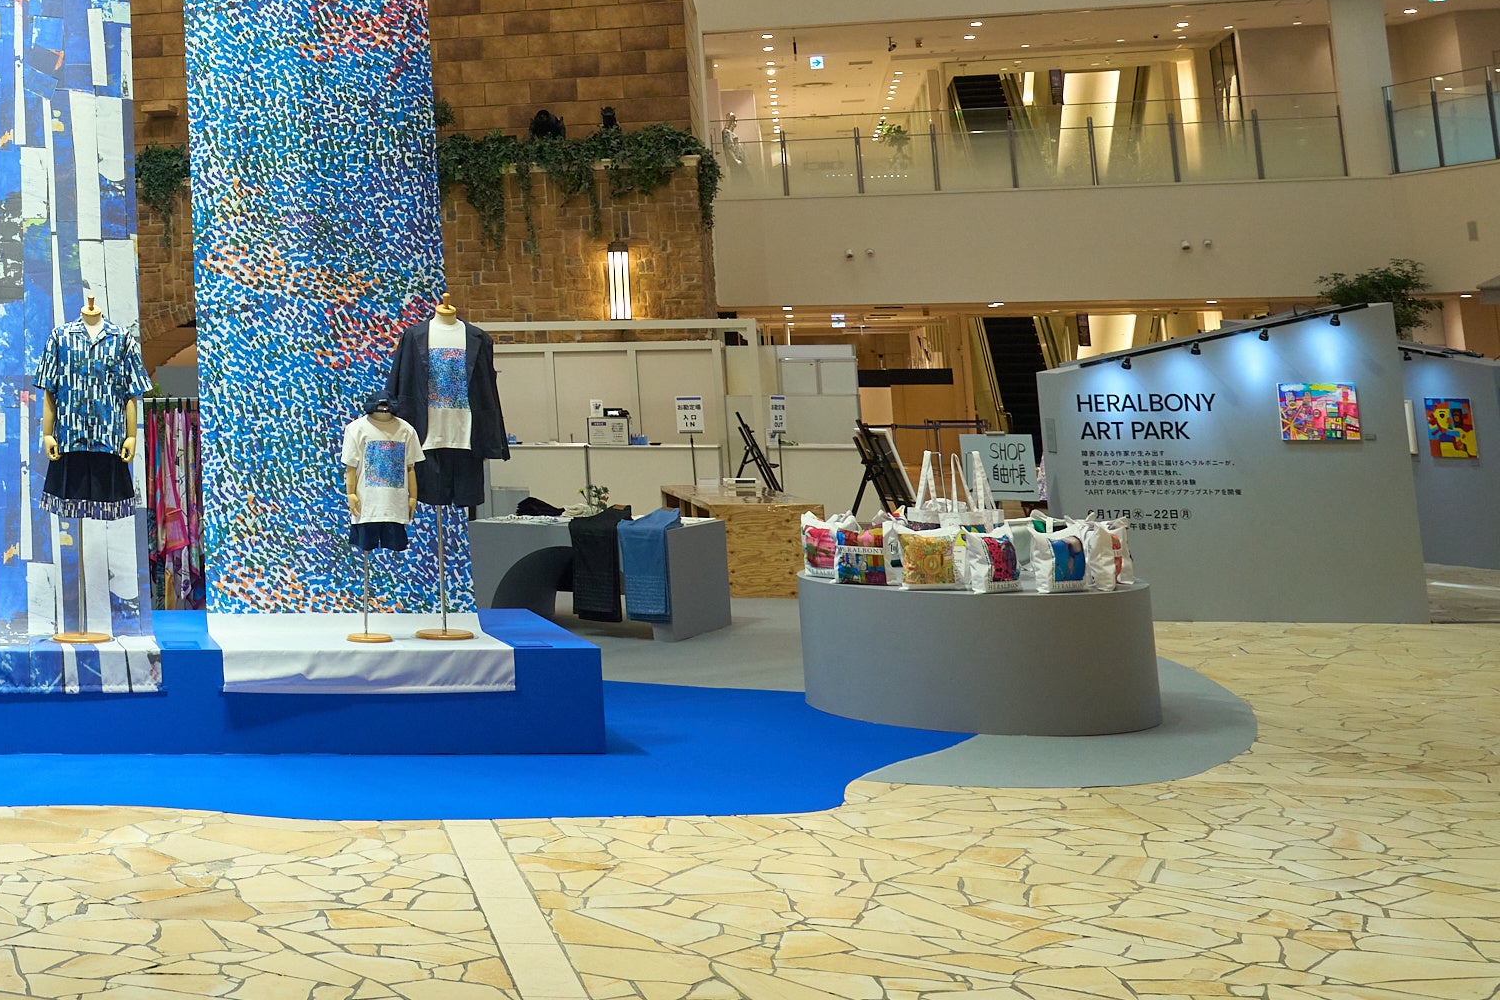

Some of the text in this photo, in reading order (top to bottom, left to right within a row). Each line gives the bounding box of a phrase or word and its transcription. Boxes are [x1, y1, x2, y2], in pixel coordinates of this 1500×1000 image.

[1076, 393, 1216, 412] HERALBONY
[1081, 421, 1191, 440] ART PARK
[989, 442, 1027, 461] SHOP
[1126, 523, 1177, 531] 午後5時まで
